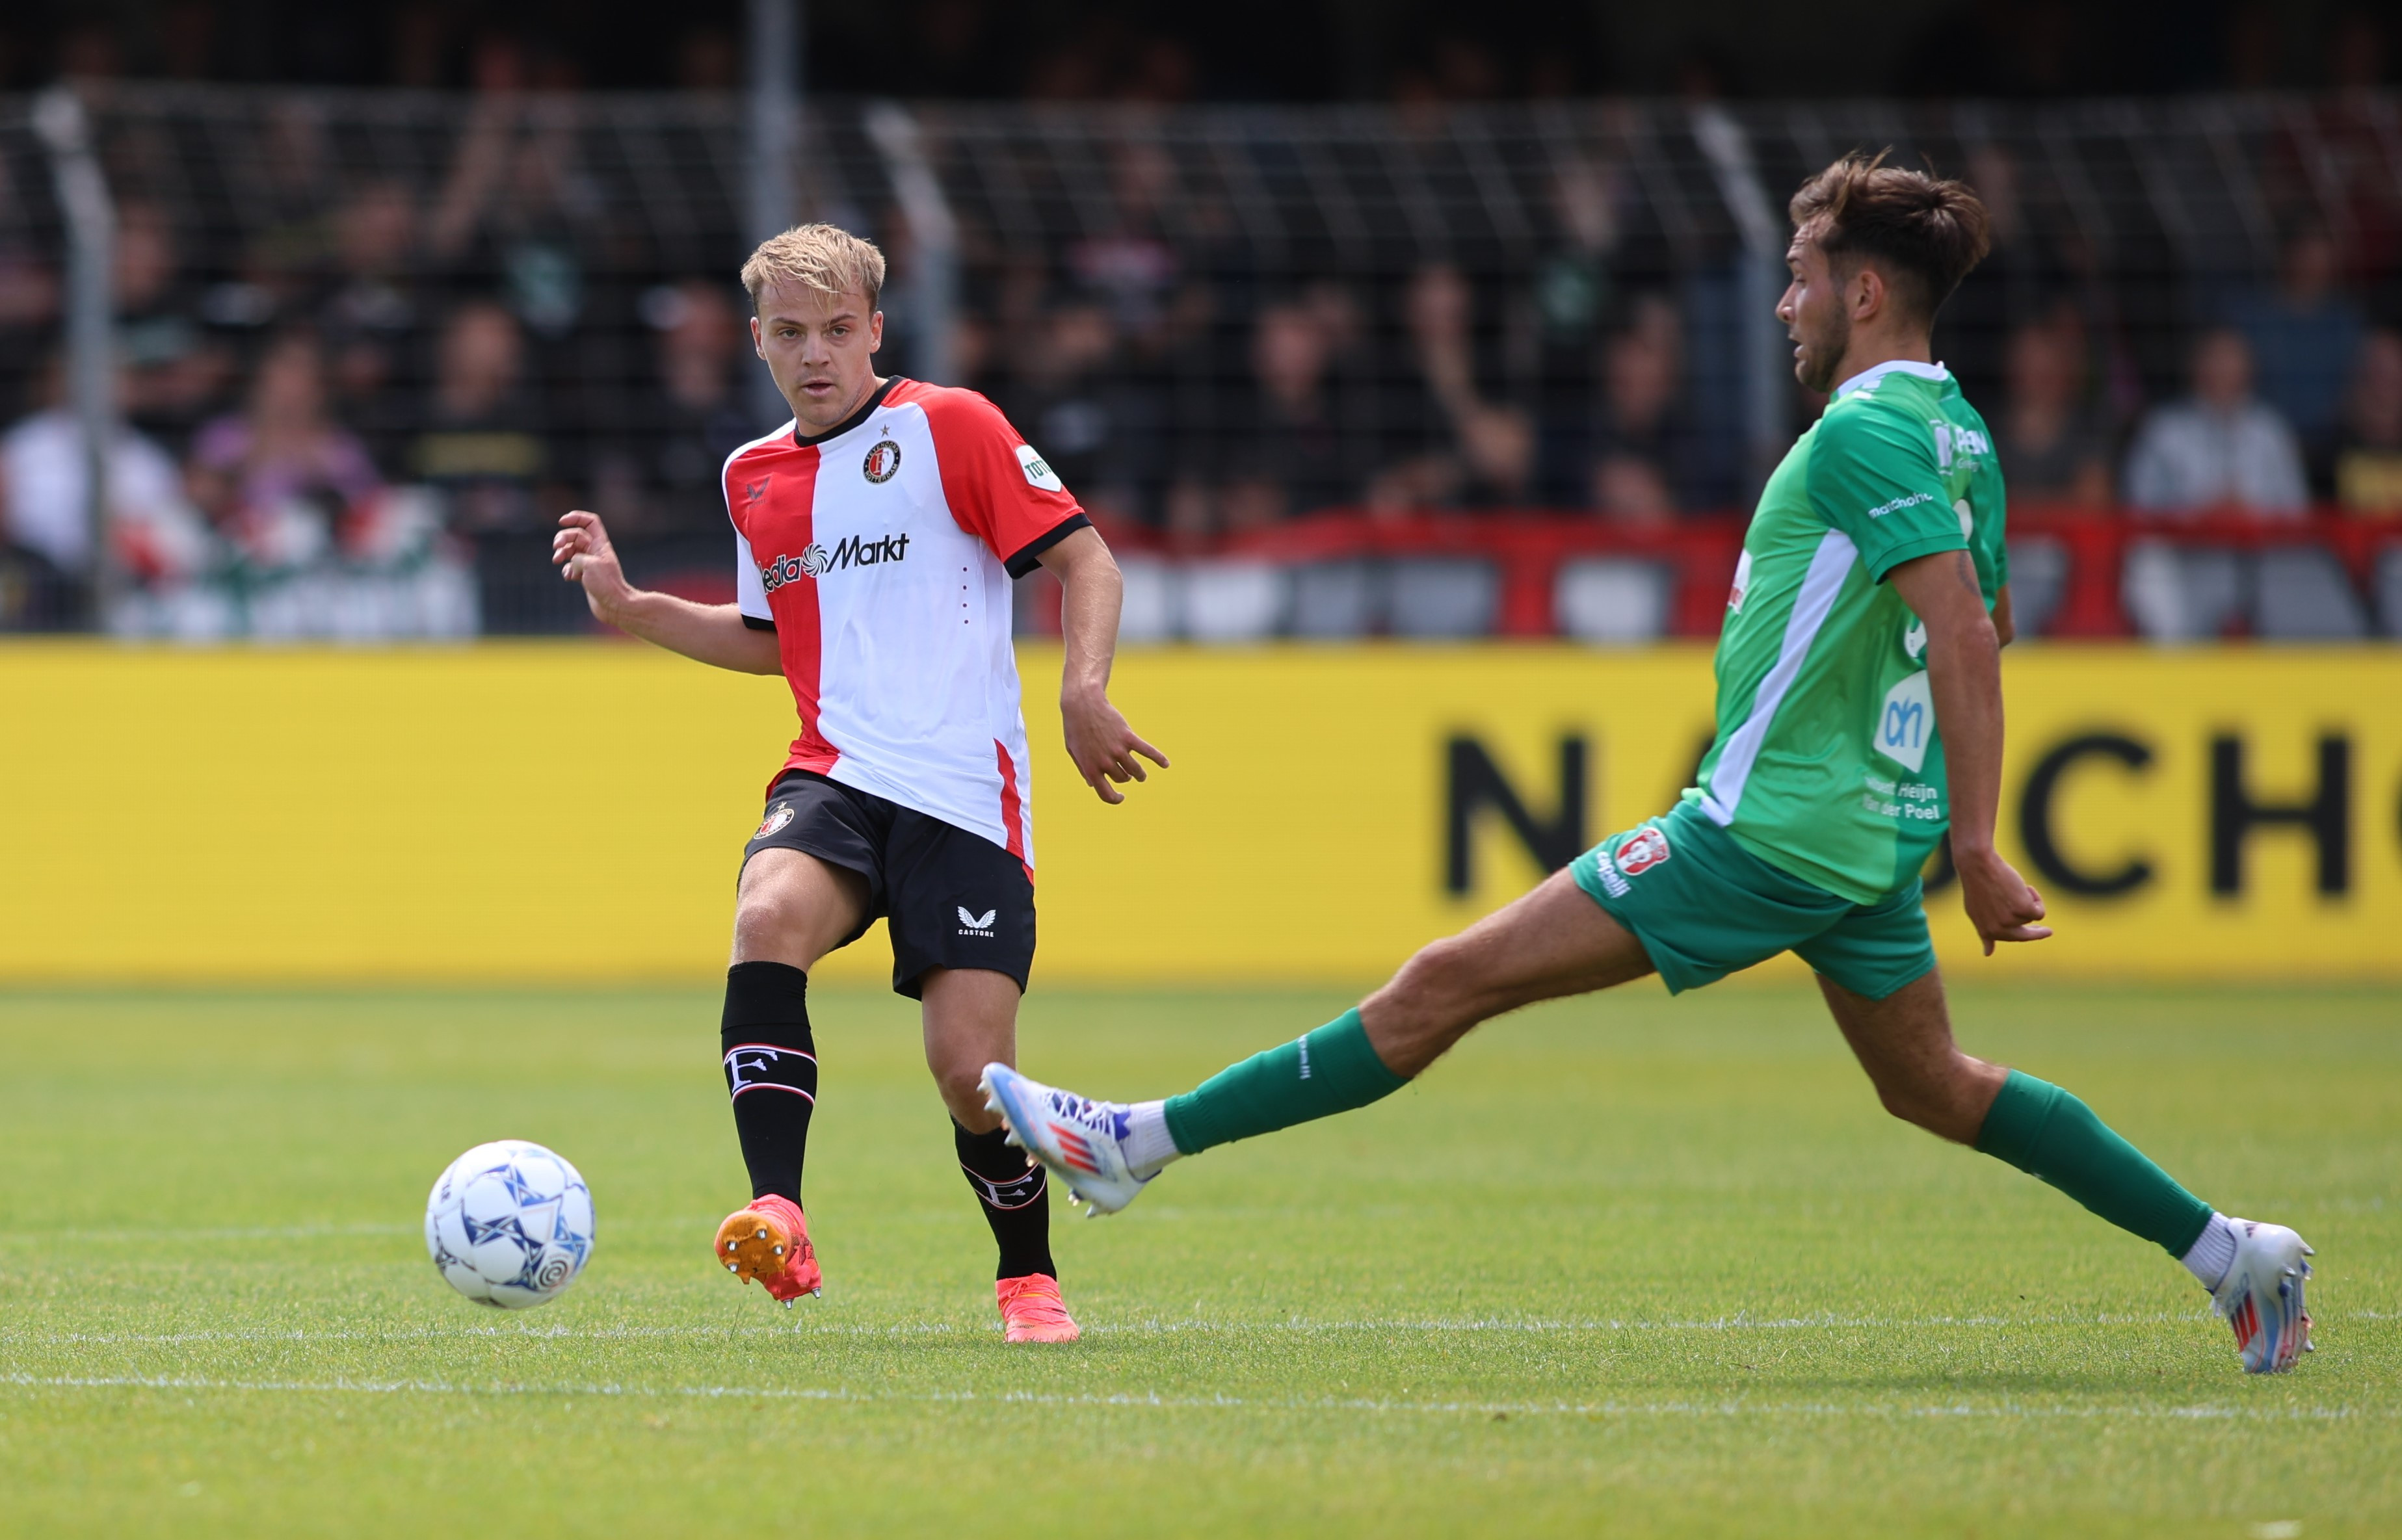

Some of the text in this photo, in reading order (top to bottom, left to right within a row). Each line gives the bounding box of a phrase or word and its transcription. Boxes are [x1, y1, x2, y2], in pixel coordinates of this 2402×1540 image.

[866, 441, 899, 460] FEYENOORD
[865, 462, 898, 483] ROTTERDAM
[825, 532, 910, 574] Markt
[1897, 782, 1938, 803] Heijn
[1904, 803, 1940, 819] Poel
[958, 928, 994, 937] CASTORE
[726, 1049, 778, 1094] F
[979, 1175, 1033, 1207] F
